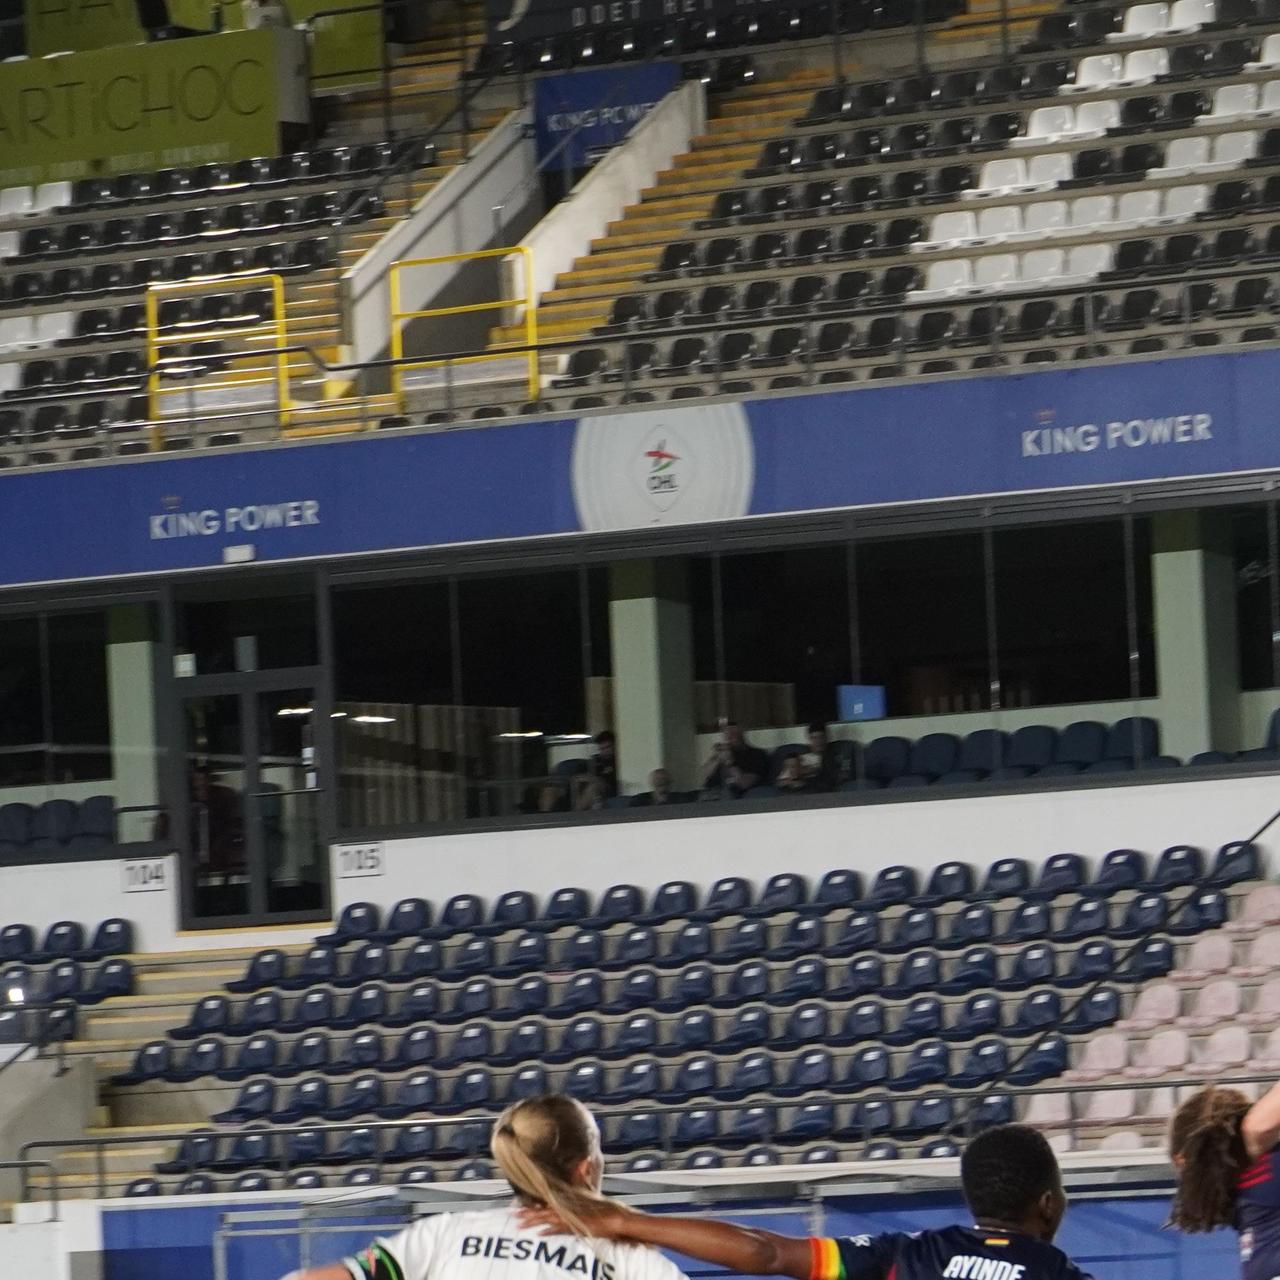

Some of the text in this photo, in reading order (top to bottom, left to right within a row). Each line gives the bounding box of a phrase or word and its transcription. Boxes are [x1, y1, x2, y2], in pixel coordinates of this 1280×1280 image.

[1021, 413, 1213, 457] KING POWER
[150, 500, 320, 540] KING POWER
